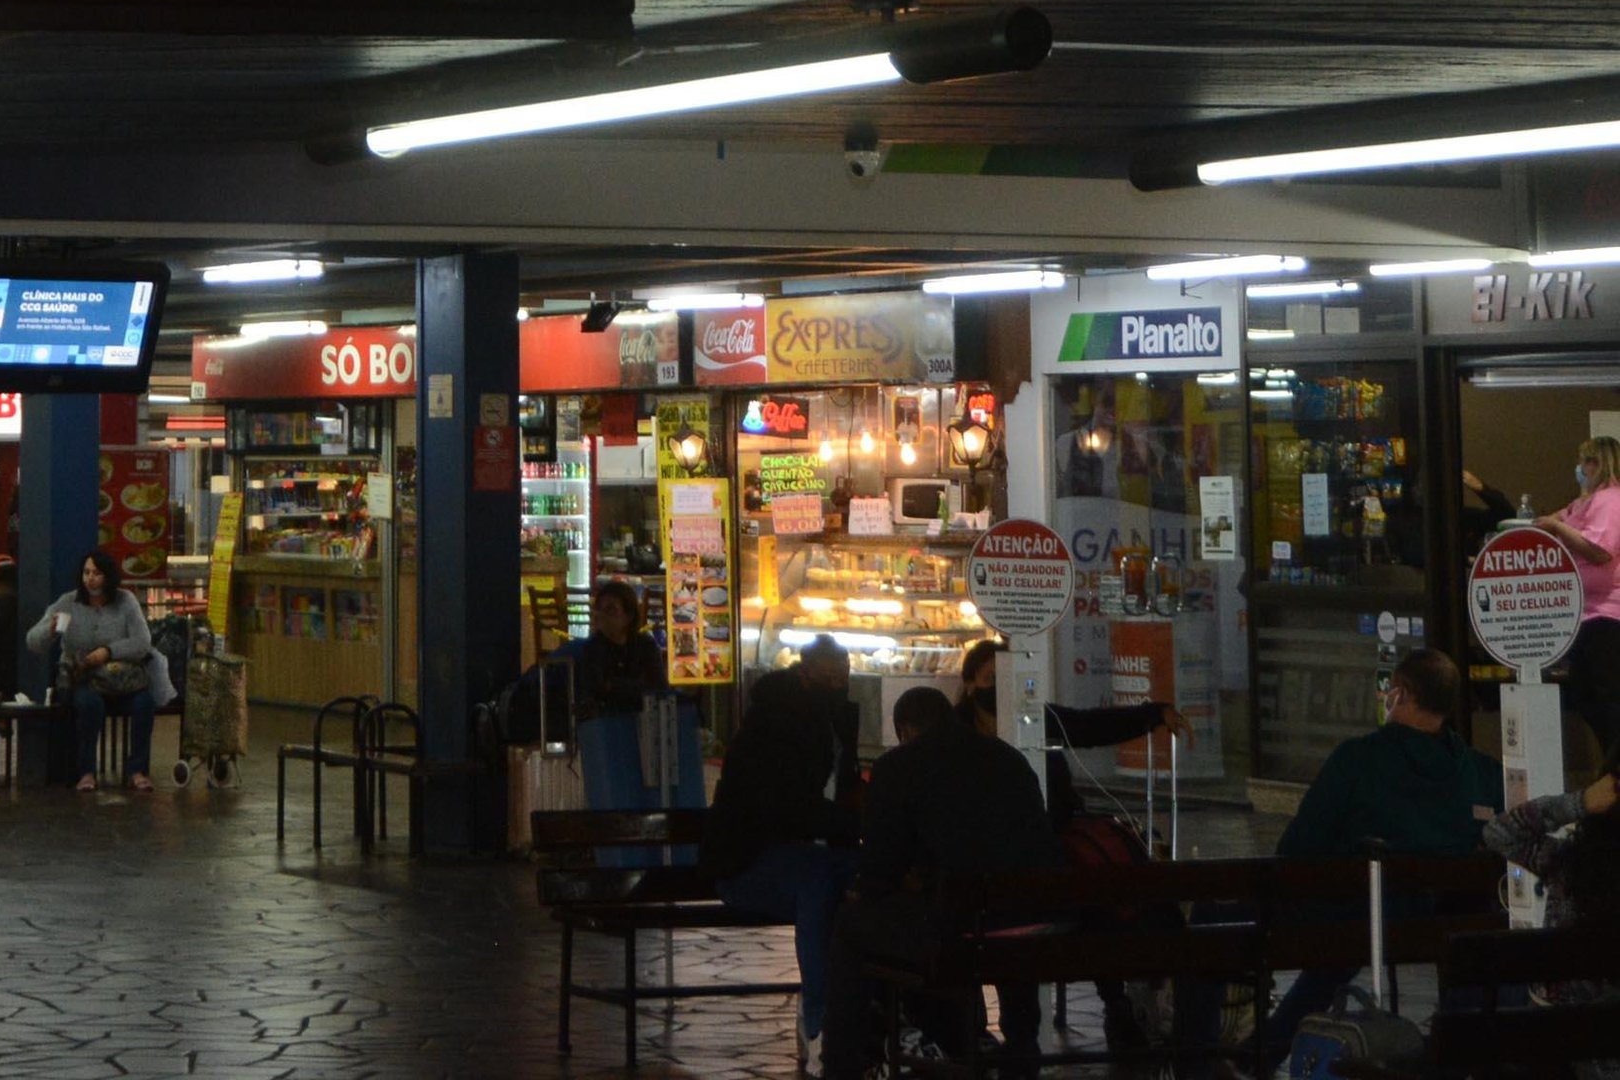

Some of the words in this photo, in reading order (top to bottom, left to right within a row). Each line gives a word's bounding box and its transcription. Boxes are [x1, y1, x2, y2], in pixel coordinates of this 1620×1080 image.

[22, 290, 61, 302] CLÍNICA
[63, 292, 86, 302] MAIS
[88, 292, 104, 302] DO
[1121, 312, 1220, 355] Planalto
[320, 336, 362, 386] SÓ
[368, 342, 417, 385] BO
[662, 366, 676, 380] 193
[983, 533, 1058, 558] ATENÇÃO!
[1483, 545, 1562, 574] ATENÇÃO!
[988, 562, 1009, 574] NÃO
[1011, 564, 1066, 576] ABANDONE
[992, 577, 1011, 588] SEU
[1014, 578, 1062, 589] CELULAR!
[1490, 581, 1513, 596] NÃO
[1516, 579, 1574, 594] ABANDONE
[1495, 599, 1517, 612] SEU
[1520, 596, 1570, 610] CELULAR!
[1113, 656, 1151, 673] ANHE
